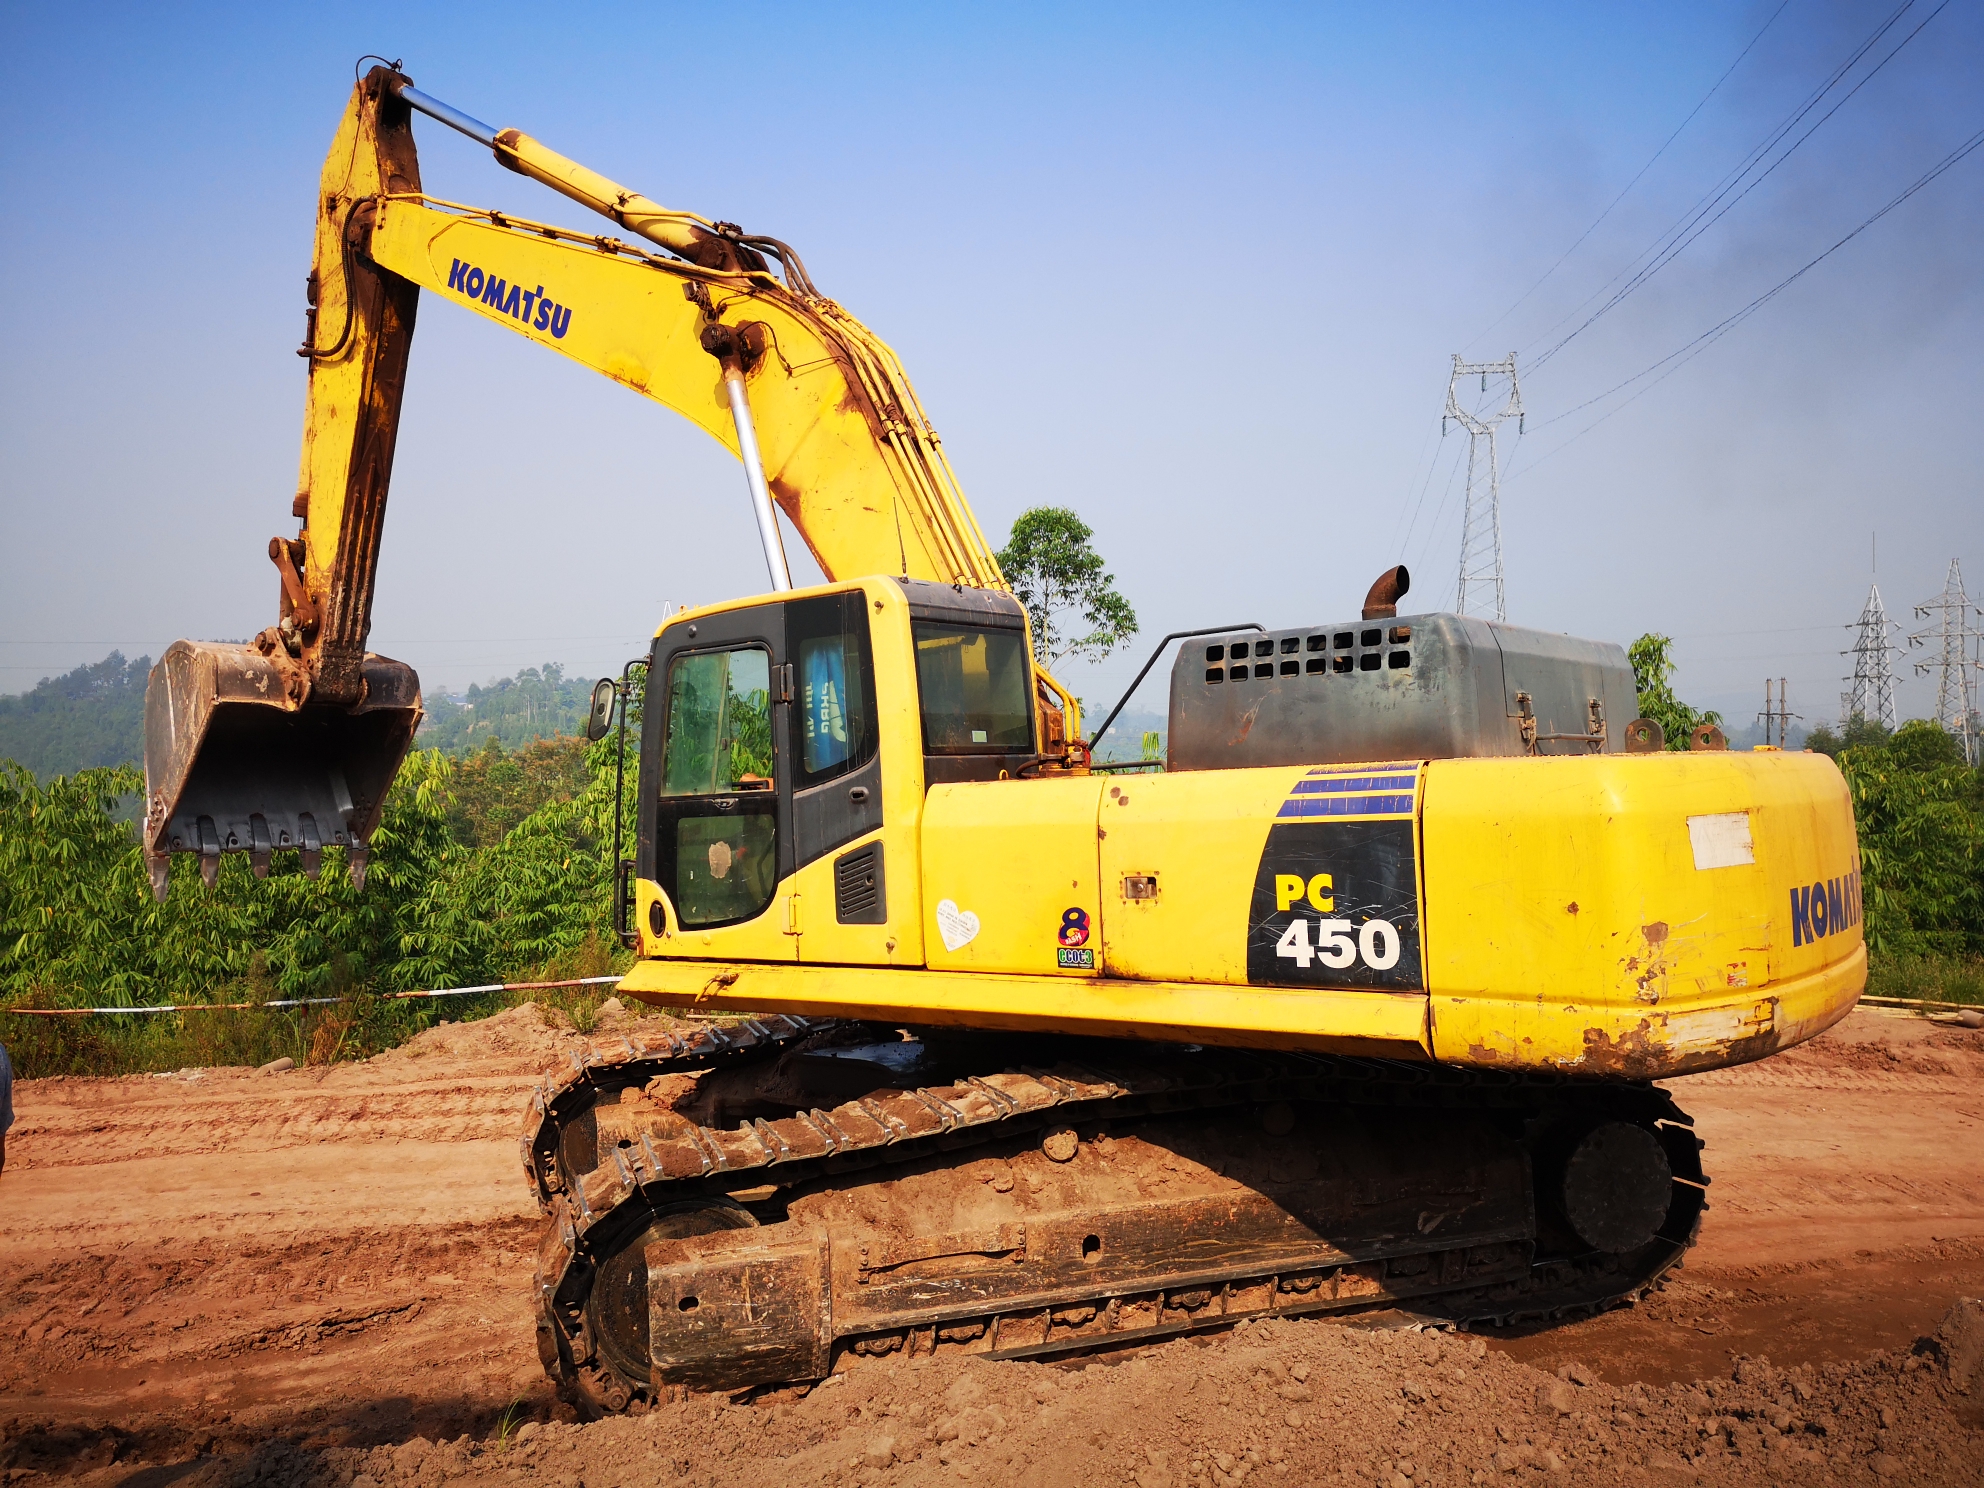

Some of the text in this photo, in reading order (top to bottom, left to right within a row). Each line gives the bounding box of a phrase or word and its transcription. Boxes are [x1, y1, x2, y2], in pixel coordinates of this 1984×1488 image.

[448, 258, 572, 339] KOMATSU
[1275, 873, 1334, 913] PC
[1790, 855, 1861, 948] KOMATS
[1058, 907, 1090, 947] 8
[1276, 919, 1400, 970] 450
